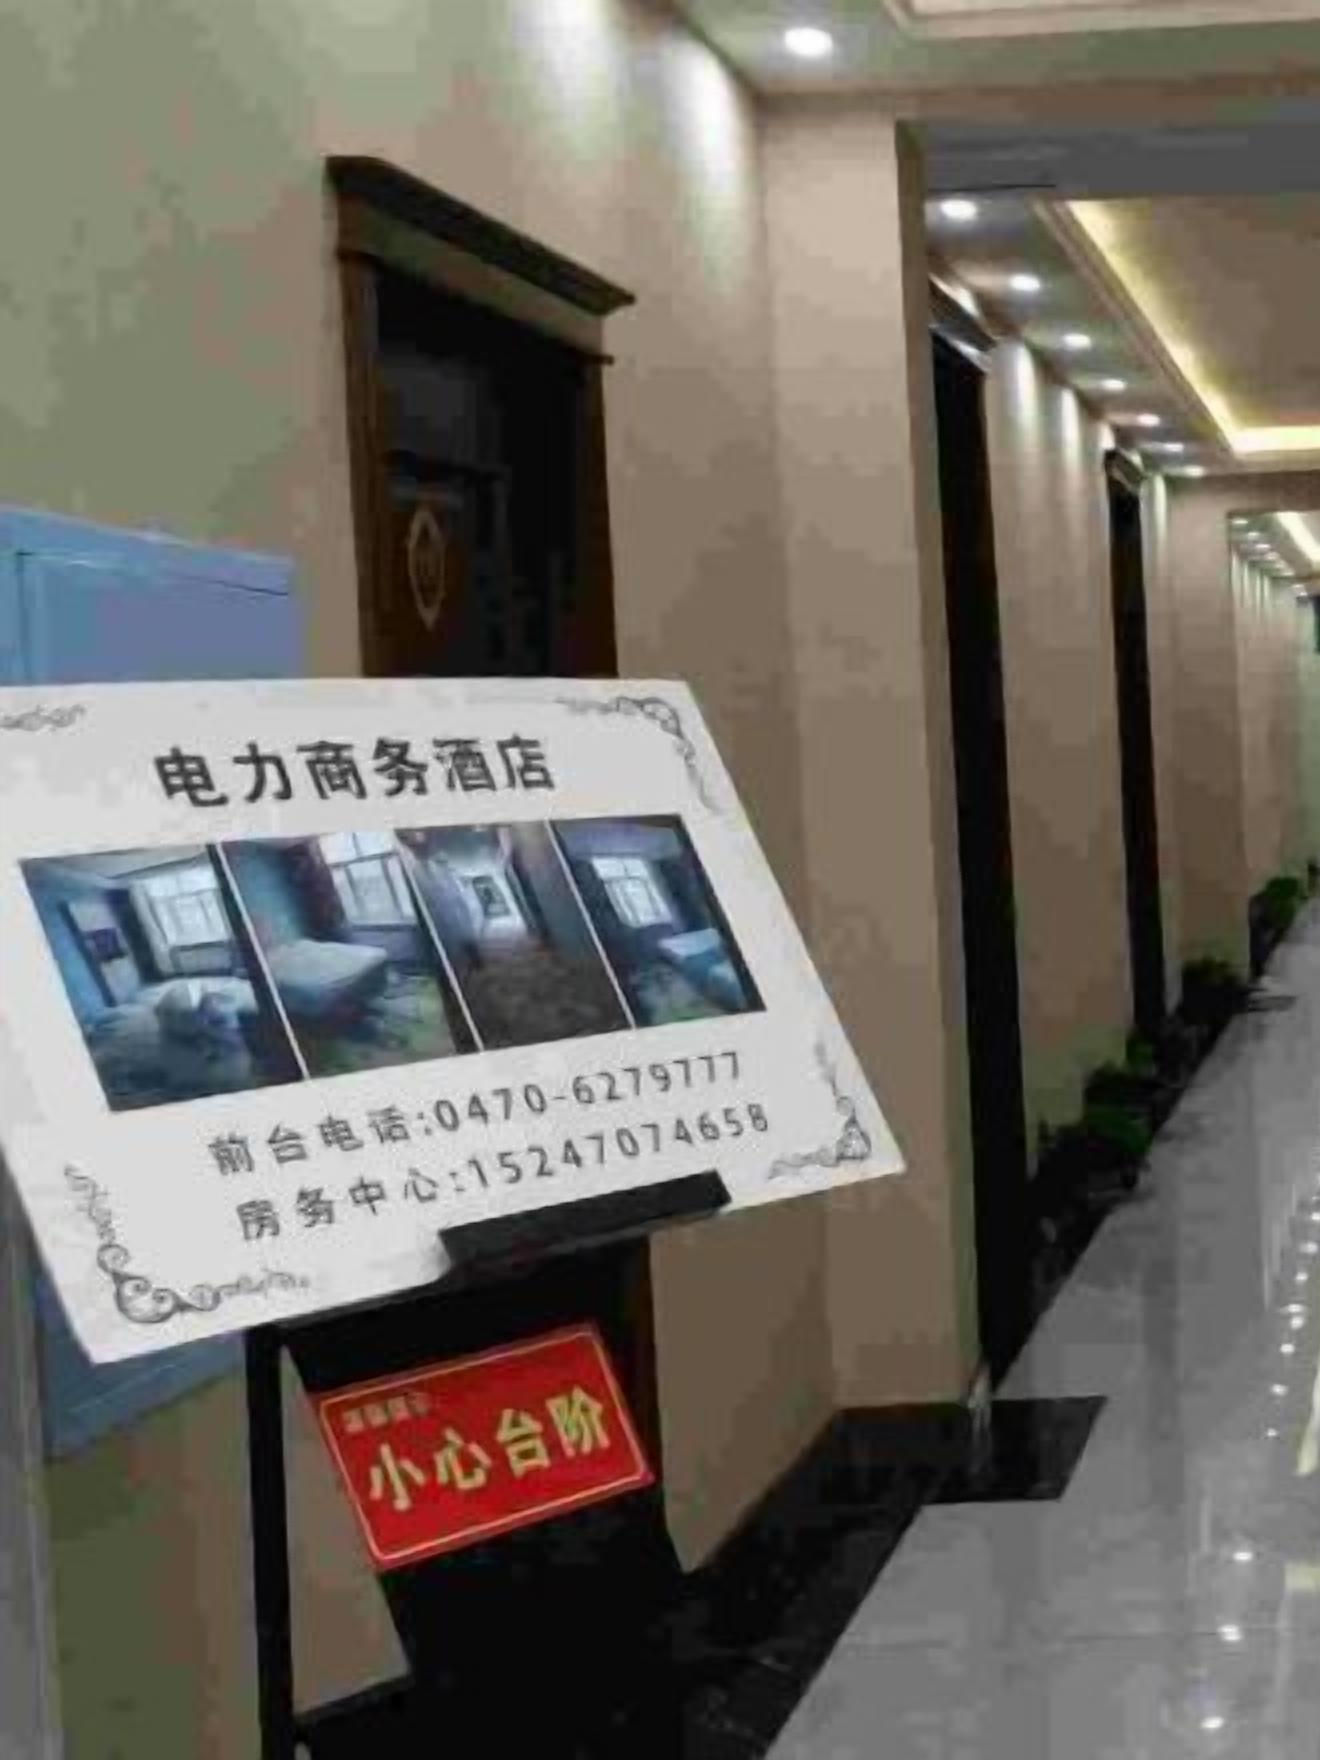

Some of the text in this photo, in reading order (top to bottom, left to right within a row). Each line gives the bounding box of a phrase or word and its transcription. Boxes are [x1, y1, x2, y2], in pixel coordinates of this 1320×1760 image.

[154, 733, 555, 807] 电力商务酒店
[369, 1385, 611, 1512] 小心台阶
